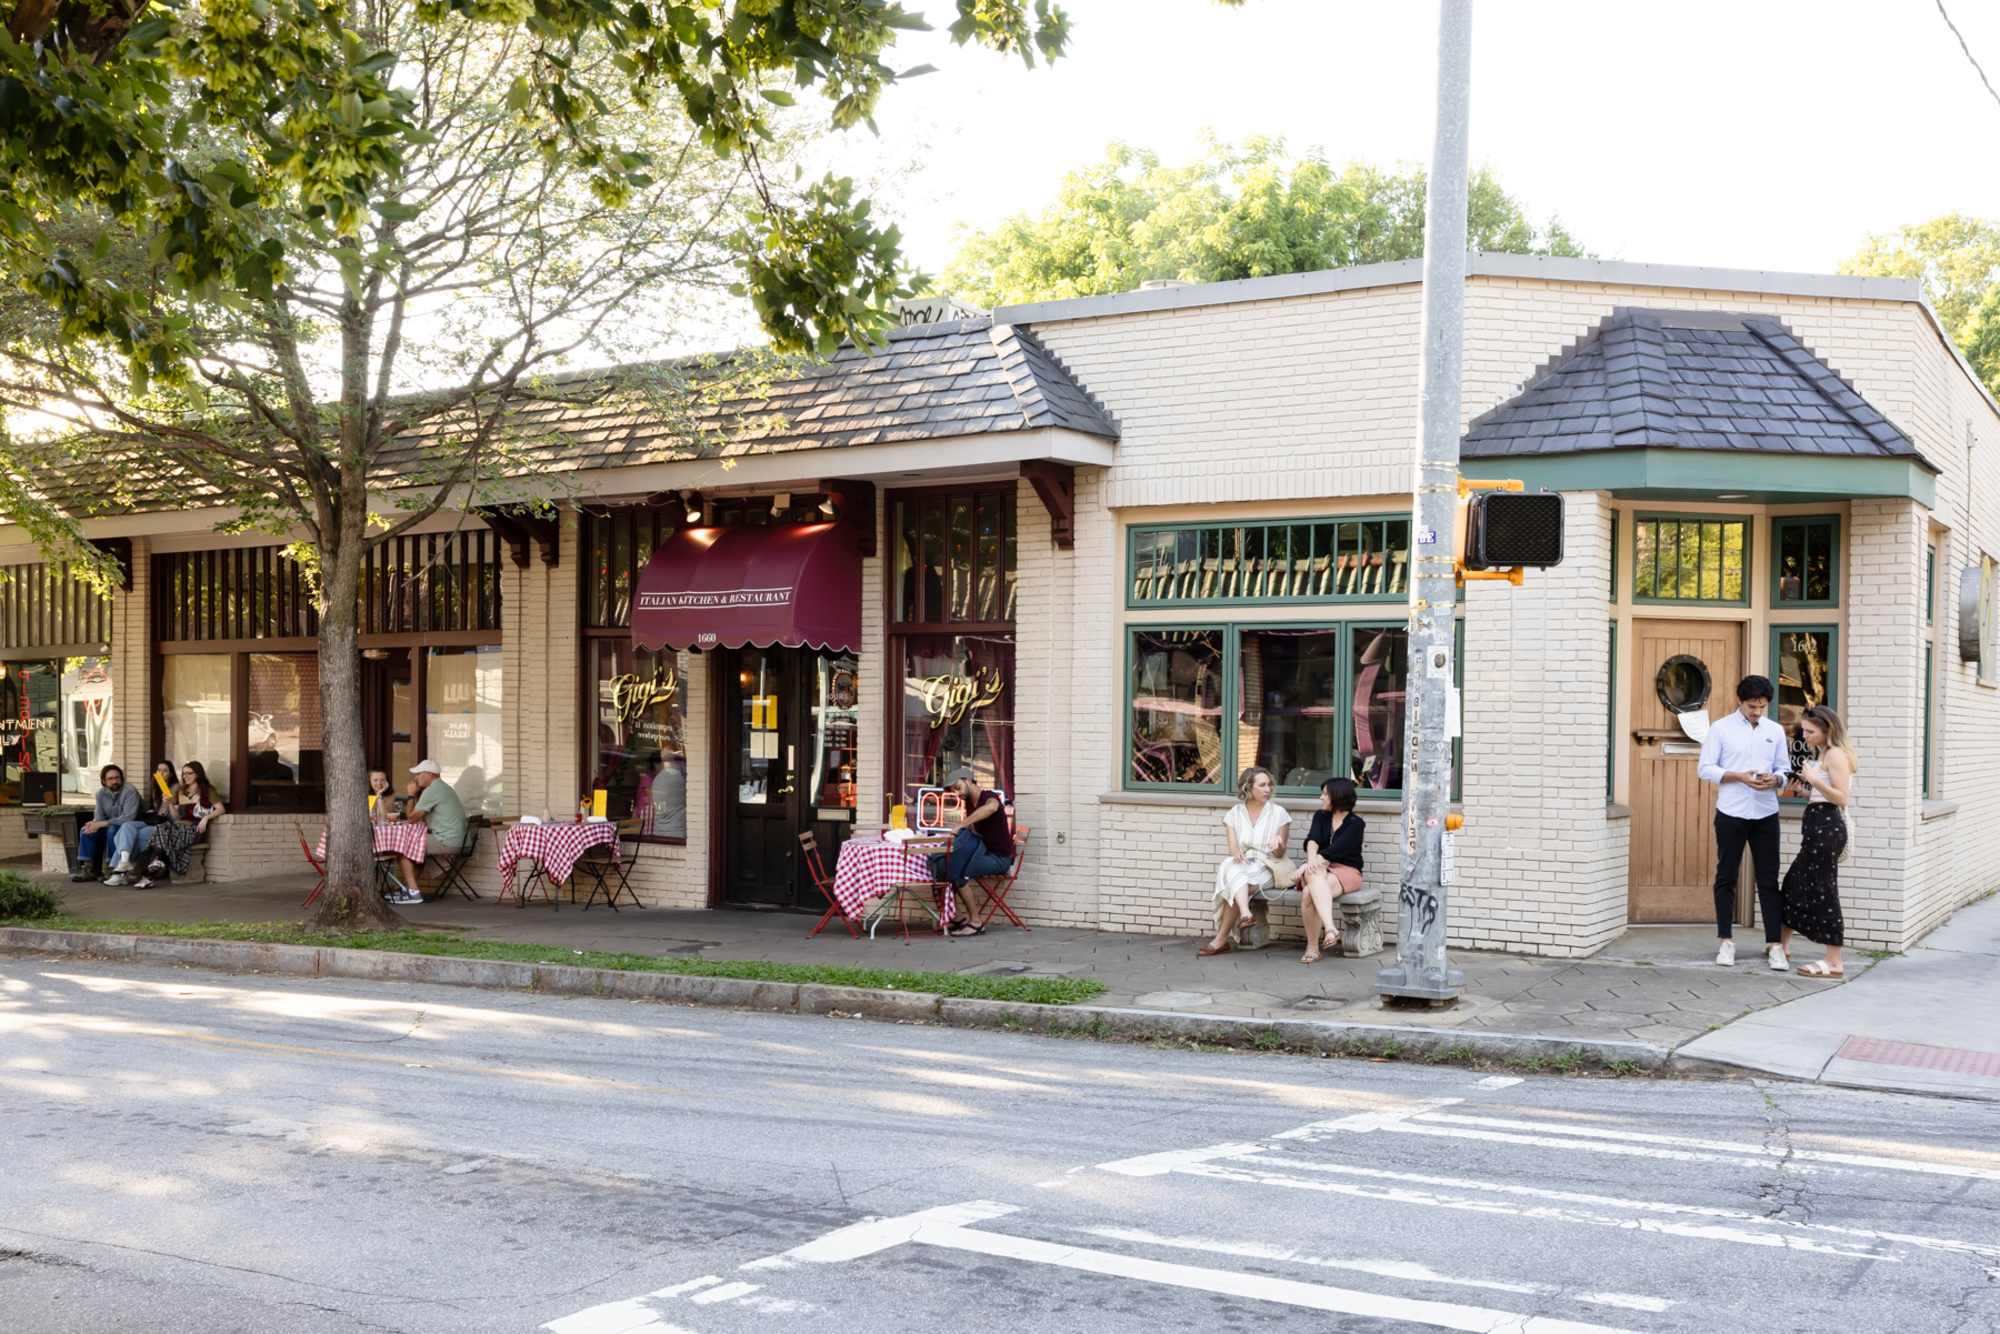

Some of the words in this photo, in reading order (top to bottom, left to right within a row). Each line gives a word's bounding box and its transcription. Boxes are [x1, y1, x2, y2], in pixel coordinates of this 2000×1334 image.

[640, 595, 678, 606] ITALIAN
[678, 594, 719, 605] KITCHEN
[720, 595, 728, 604] &
[729, 591, 791, 604] RESTAURANT
[608, 667, 679, 723] Gigi's
[921, 665, 1005, 729] Gigi's
